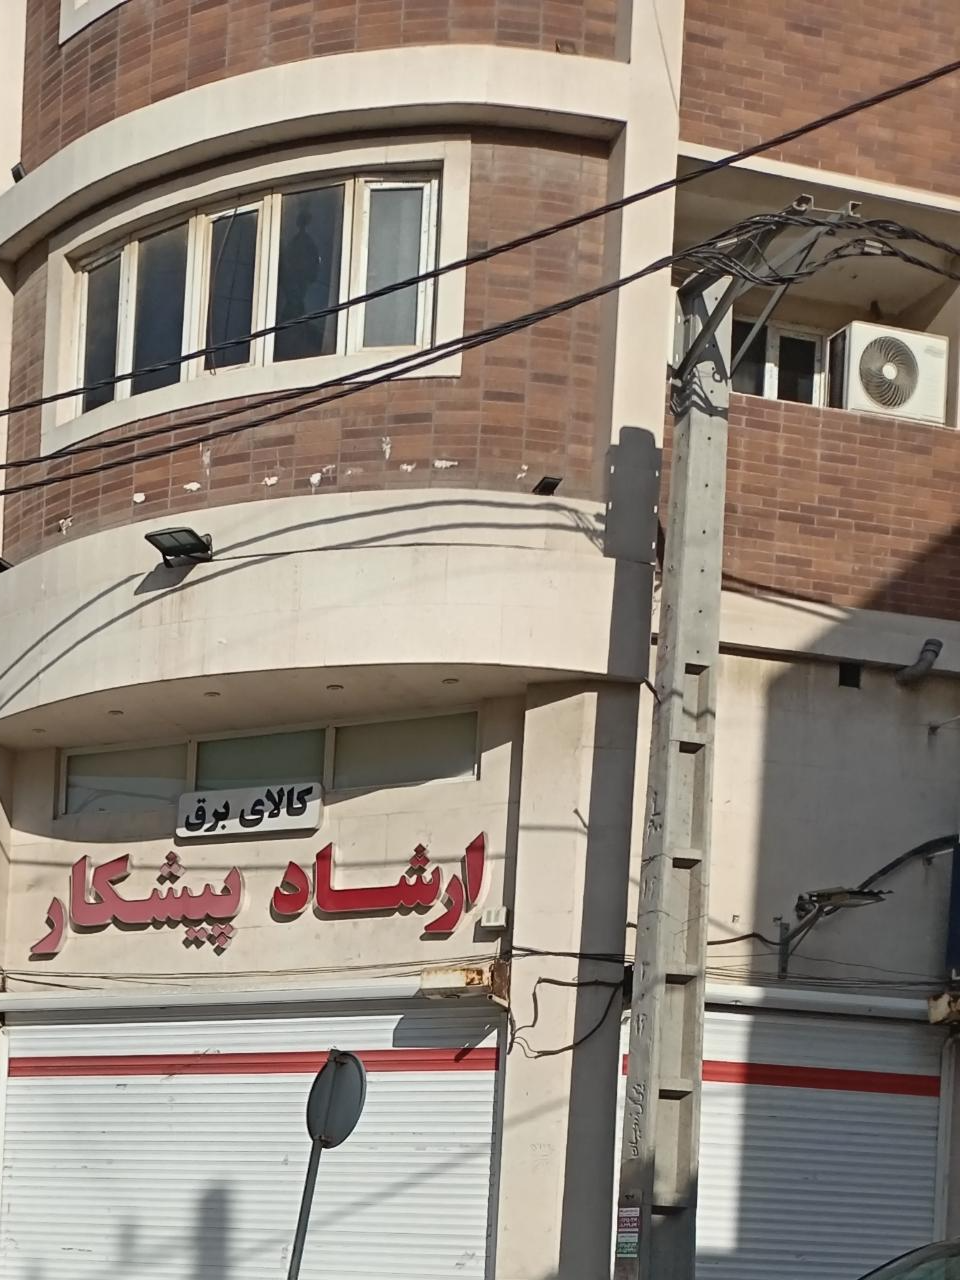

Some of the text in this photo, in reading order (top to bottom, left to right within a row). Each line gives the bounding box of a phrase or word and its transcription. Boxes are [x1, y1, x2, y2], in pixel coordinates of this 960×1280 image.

[184, 785, 314, 833] کالای برق
[29, 831, 488, 955] ارشاد پیشکار
